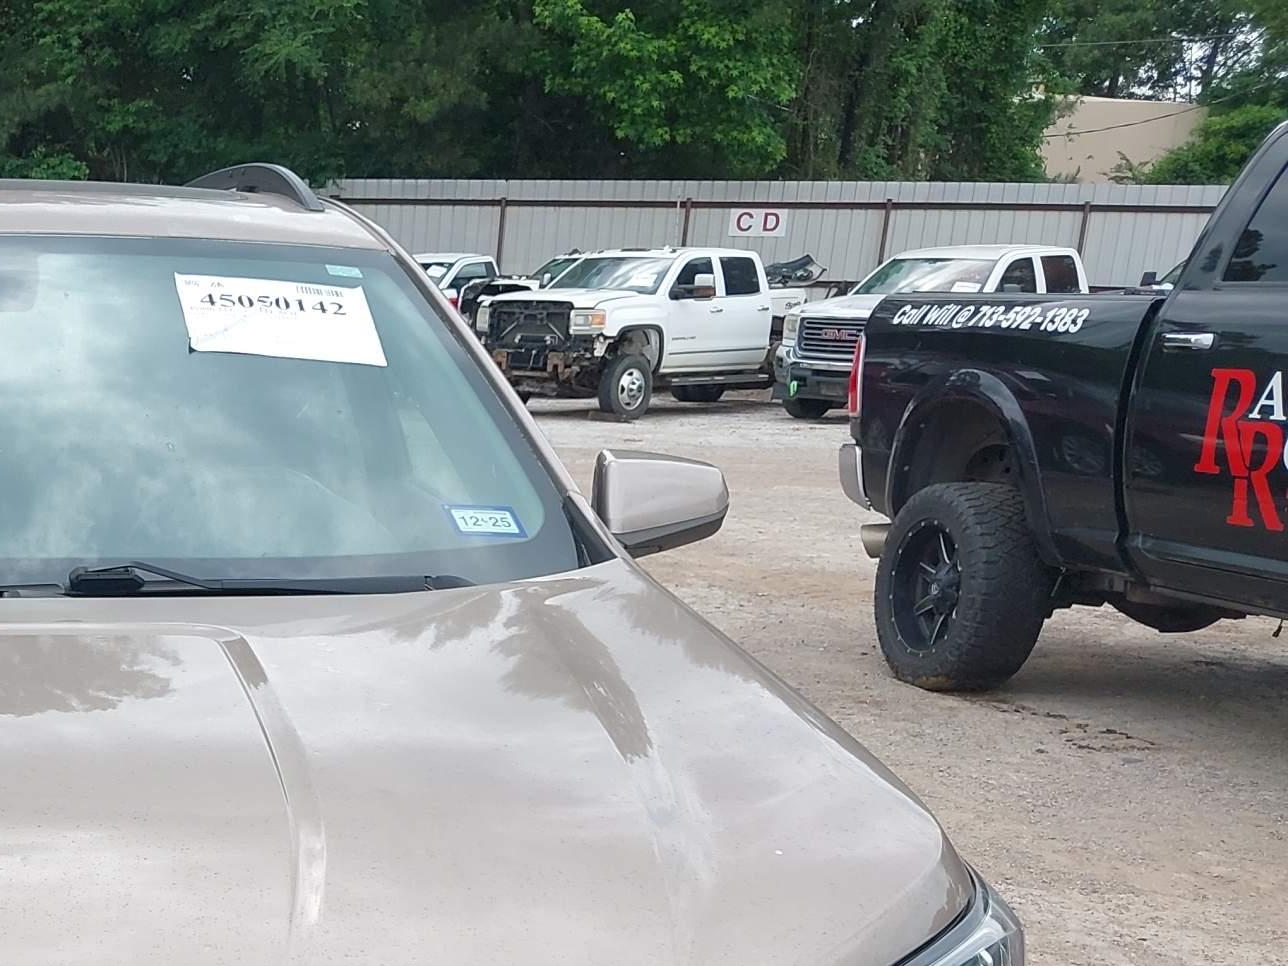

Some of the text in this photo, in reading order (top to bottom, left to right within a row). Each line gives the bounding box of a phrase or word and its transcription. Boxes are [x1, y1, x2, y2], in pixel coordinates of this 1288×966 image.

[200, 292, 347, 316] 45050142
[893, 304, 927, 325] Call
[922, 304, 962, 327] Will
[968, 305, 1090, 334] 713-592-1383
[822, 328, 857, 340] GMC
